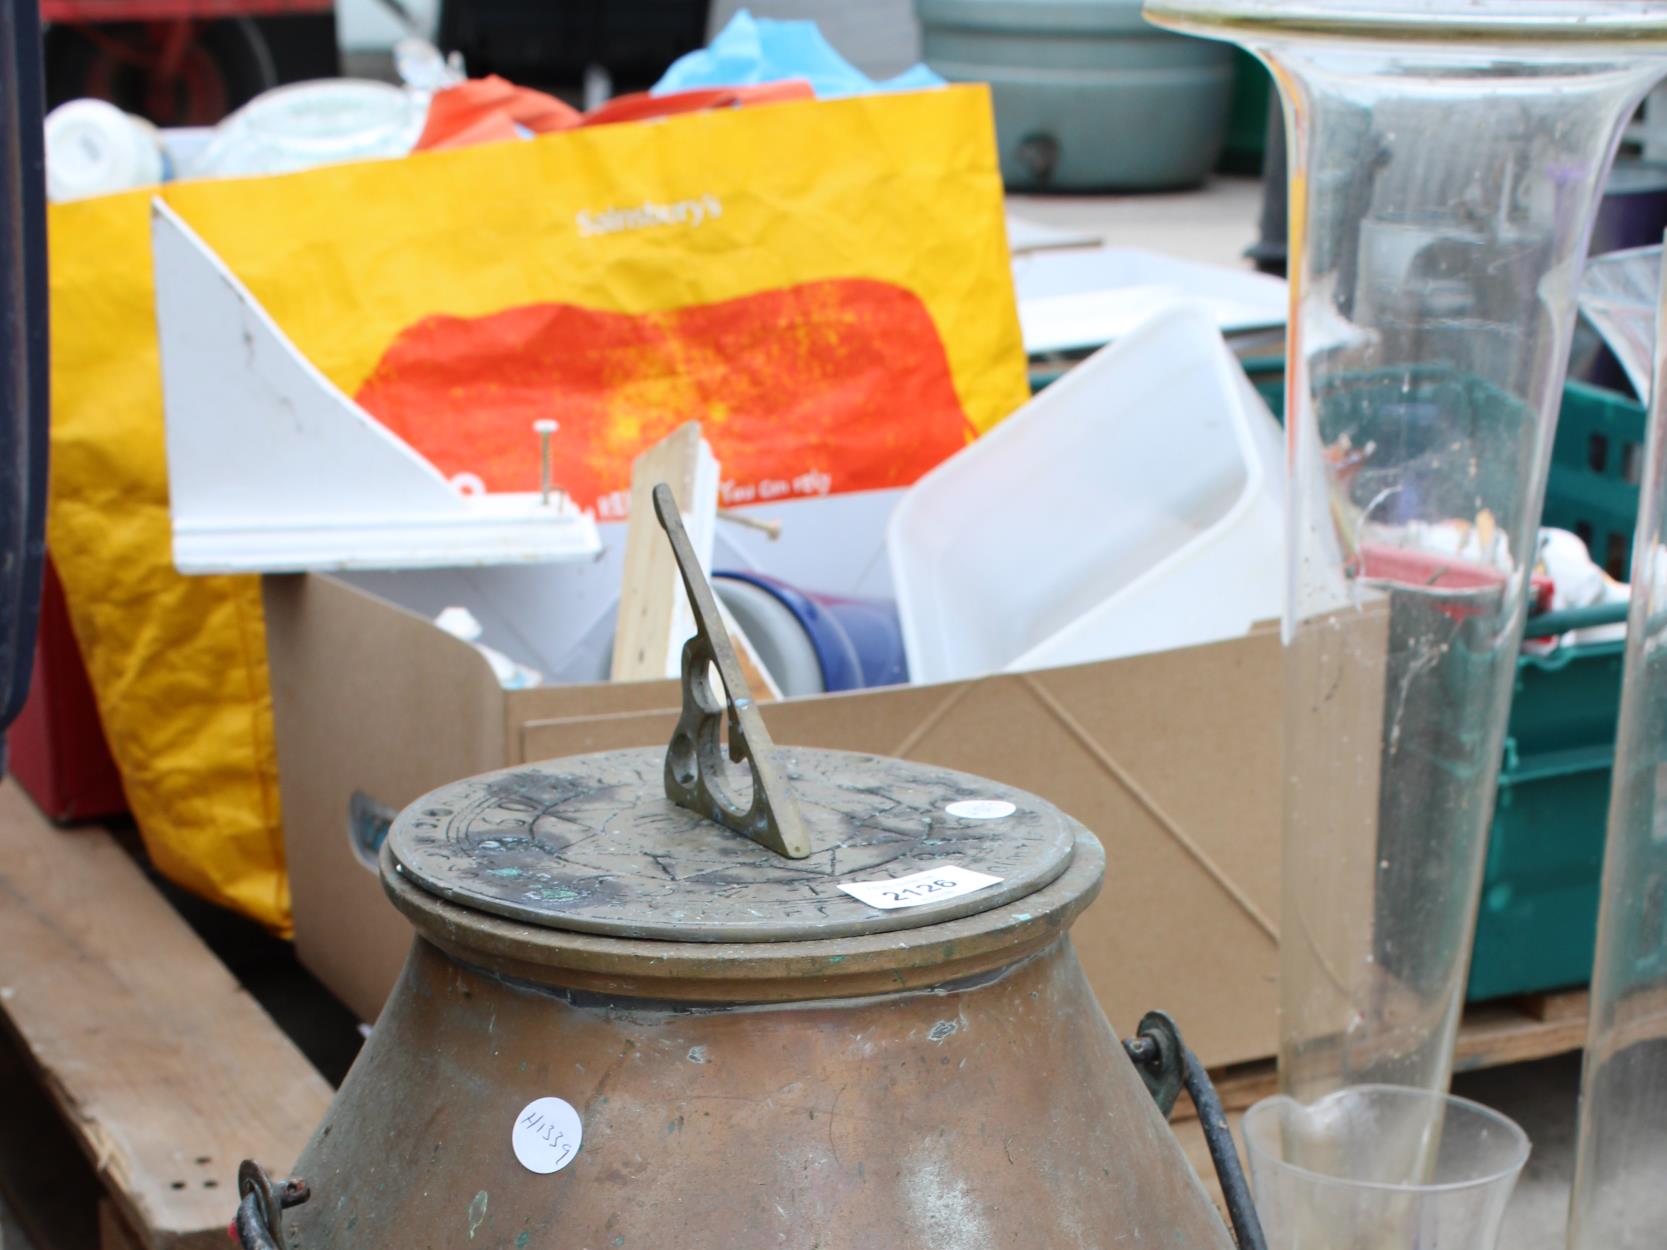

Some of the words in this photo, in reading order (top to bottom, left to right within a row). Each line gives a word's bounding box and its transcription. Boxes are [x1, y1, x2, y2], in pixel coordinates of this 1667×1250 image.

[576, 193, 722, 238] Sainsbury's
[882, 880, 957, 901] 2126
[520, 1111, 572, 1165] H1339
